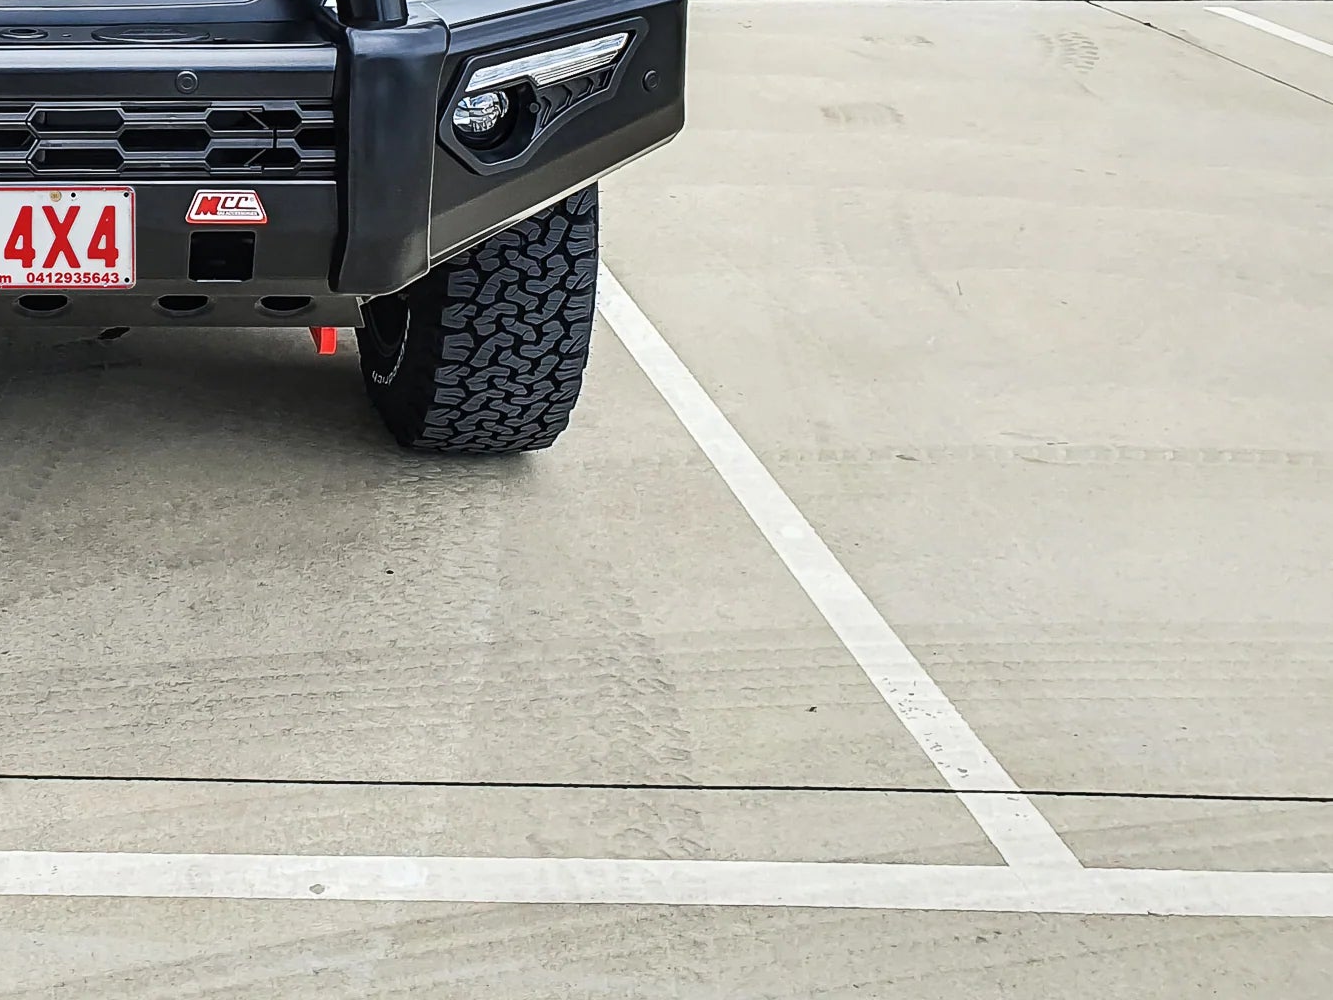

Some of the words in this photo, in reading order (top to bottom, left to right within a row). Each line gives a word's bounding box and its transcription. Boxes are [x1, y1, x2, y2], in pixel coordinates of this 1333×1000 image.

[195, 196, 258, 216] MCC
[3, 205, 120, 269] 4X4
[26, 271, 120, 284] 0412935643
